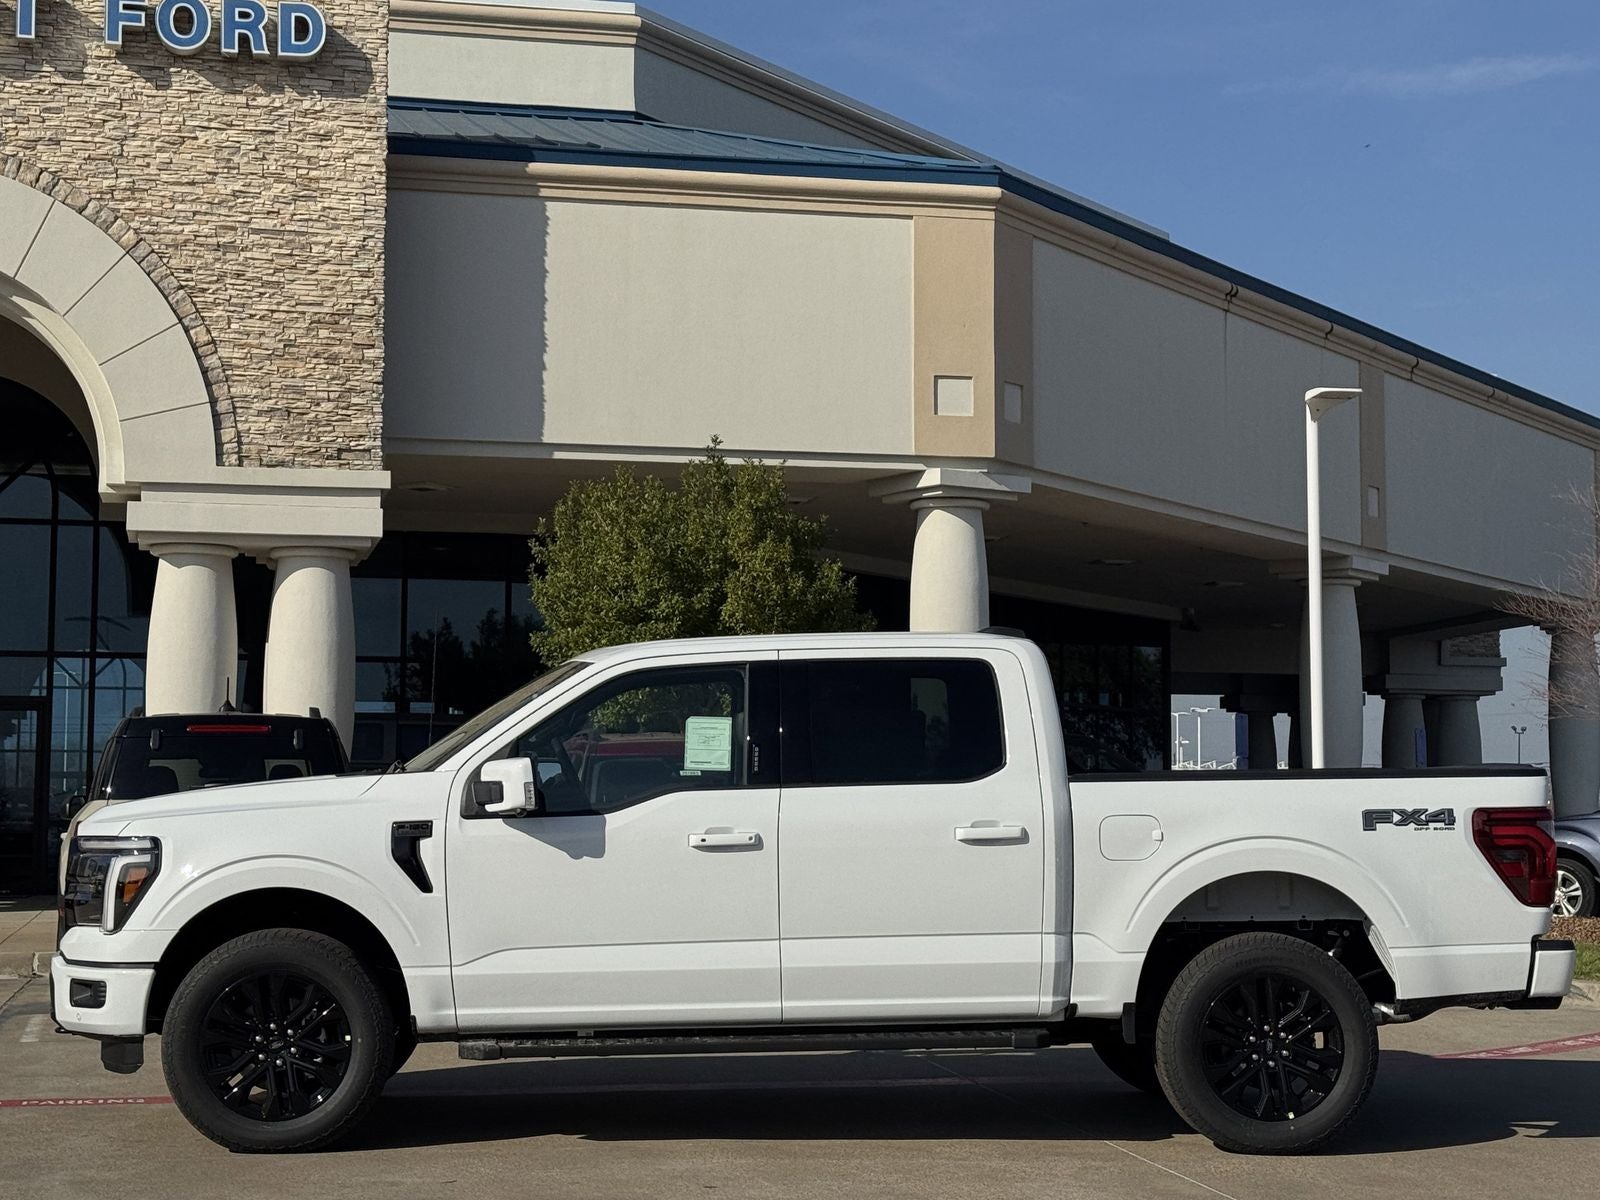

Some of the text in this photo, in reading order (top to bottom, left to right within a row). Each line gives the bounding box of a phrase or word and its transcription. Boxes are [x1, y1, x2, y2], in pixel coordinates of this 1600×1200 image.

[104, 0, 327, 58] FORD
[1362, 808, 1456, 831] FX4
[22, 1098, 145, 1106] PARKING
